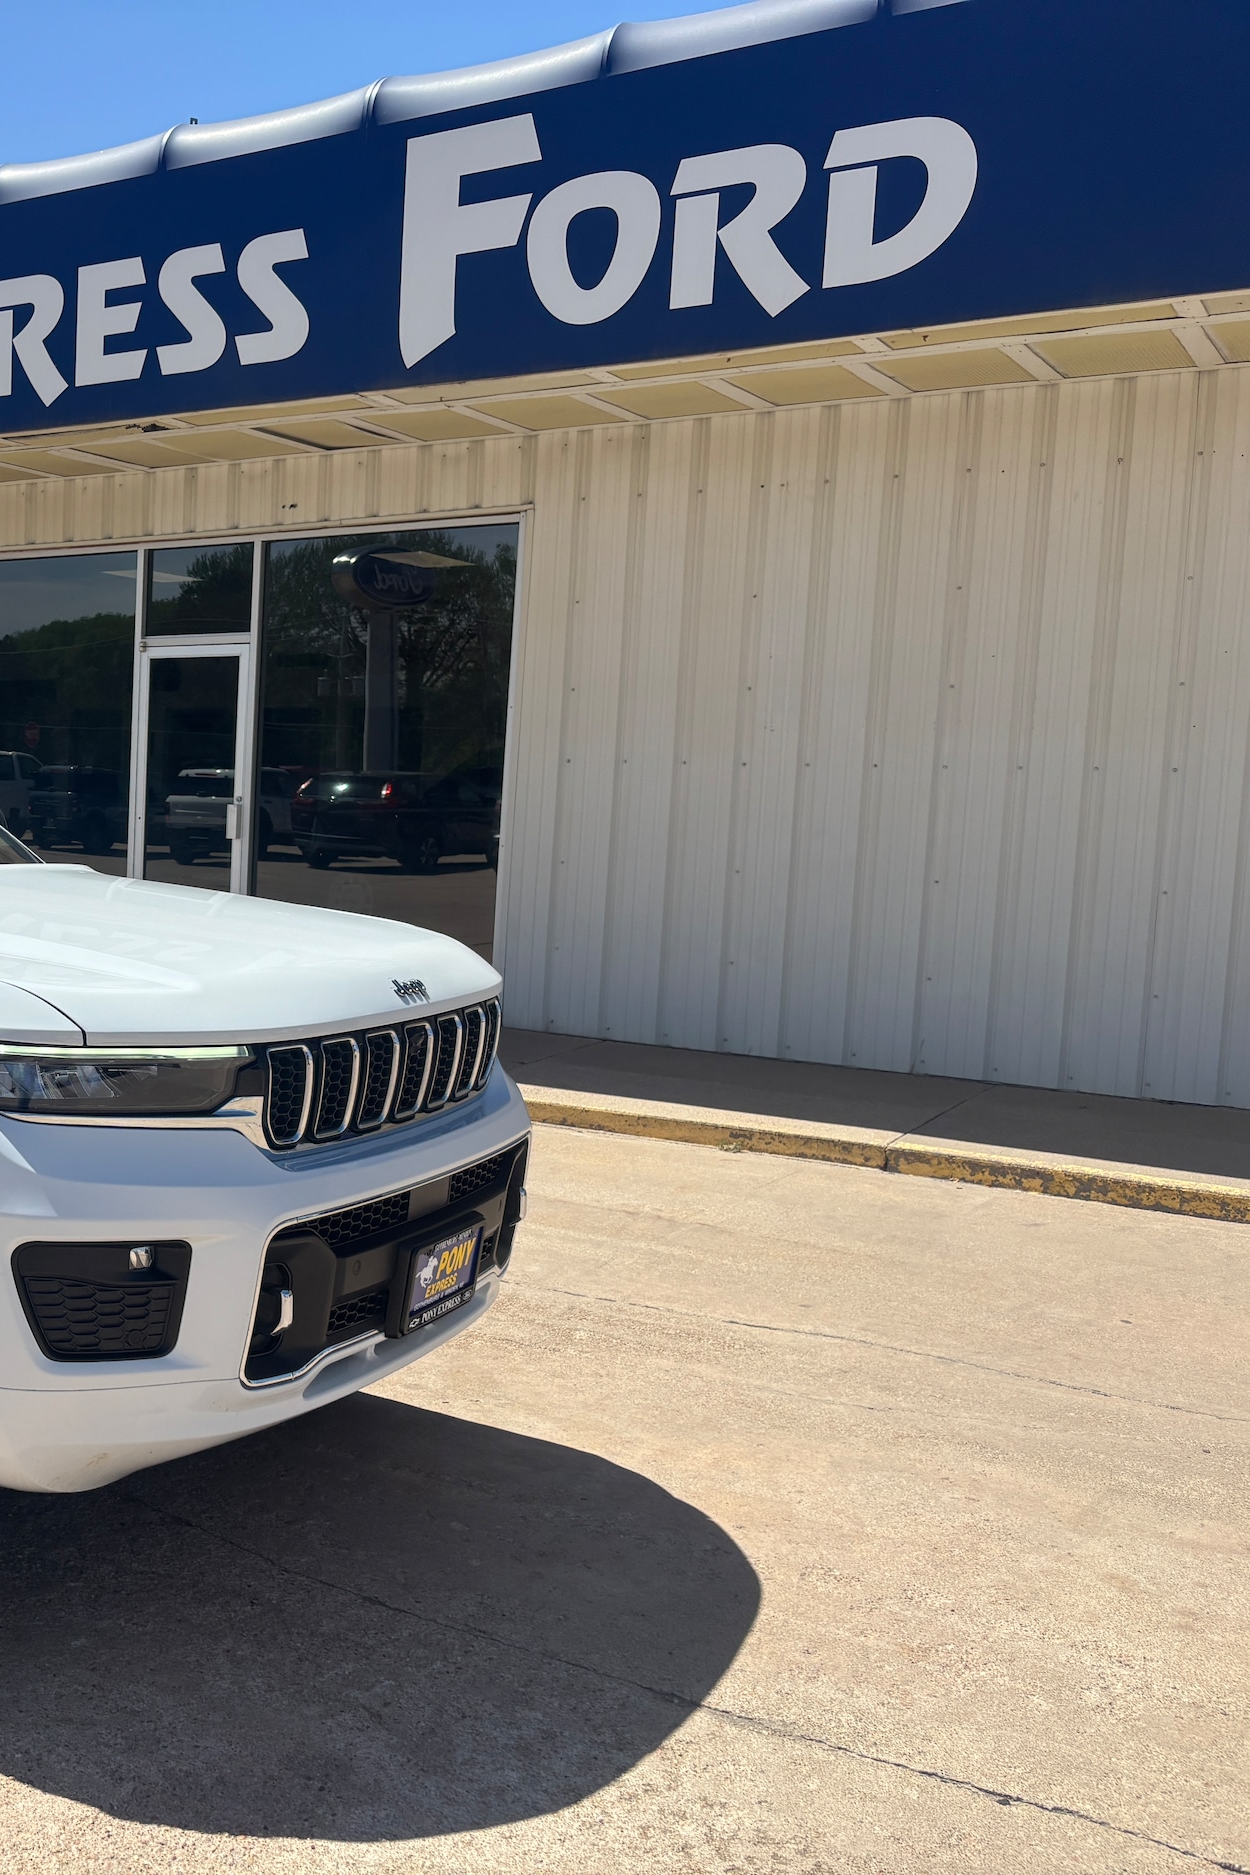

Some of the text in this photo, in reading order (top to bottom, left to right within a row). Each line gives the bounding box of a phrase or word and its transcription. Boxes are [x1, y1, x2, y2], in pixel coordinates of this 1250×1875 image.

[398, 112, 979, 370] FORD
[436, 1237, 477, 1280] PONY
[424, 1272, 458, 1299] EXPRESS
[437, 1294, 462, 1316] EXPRESS
